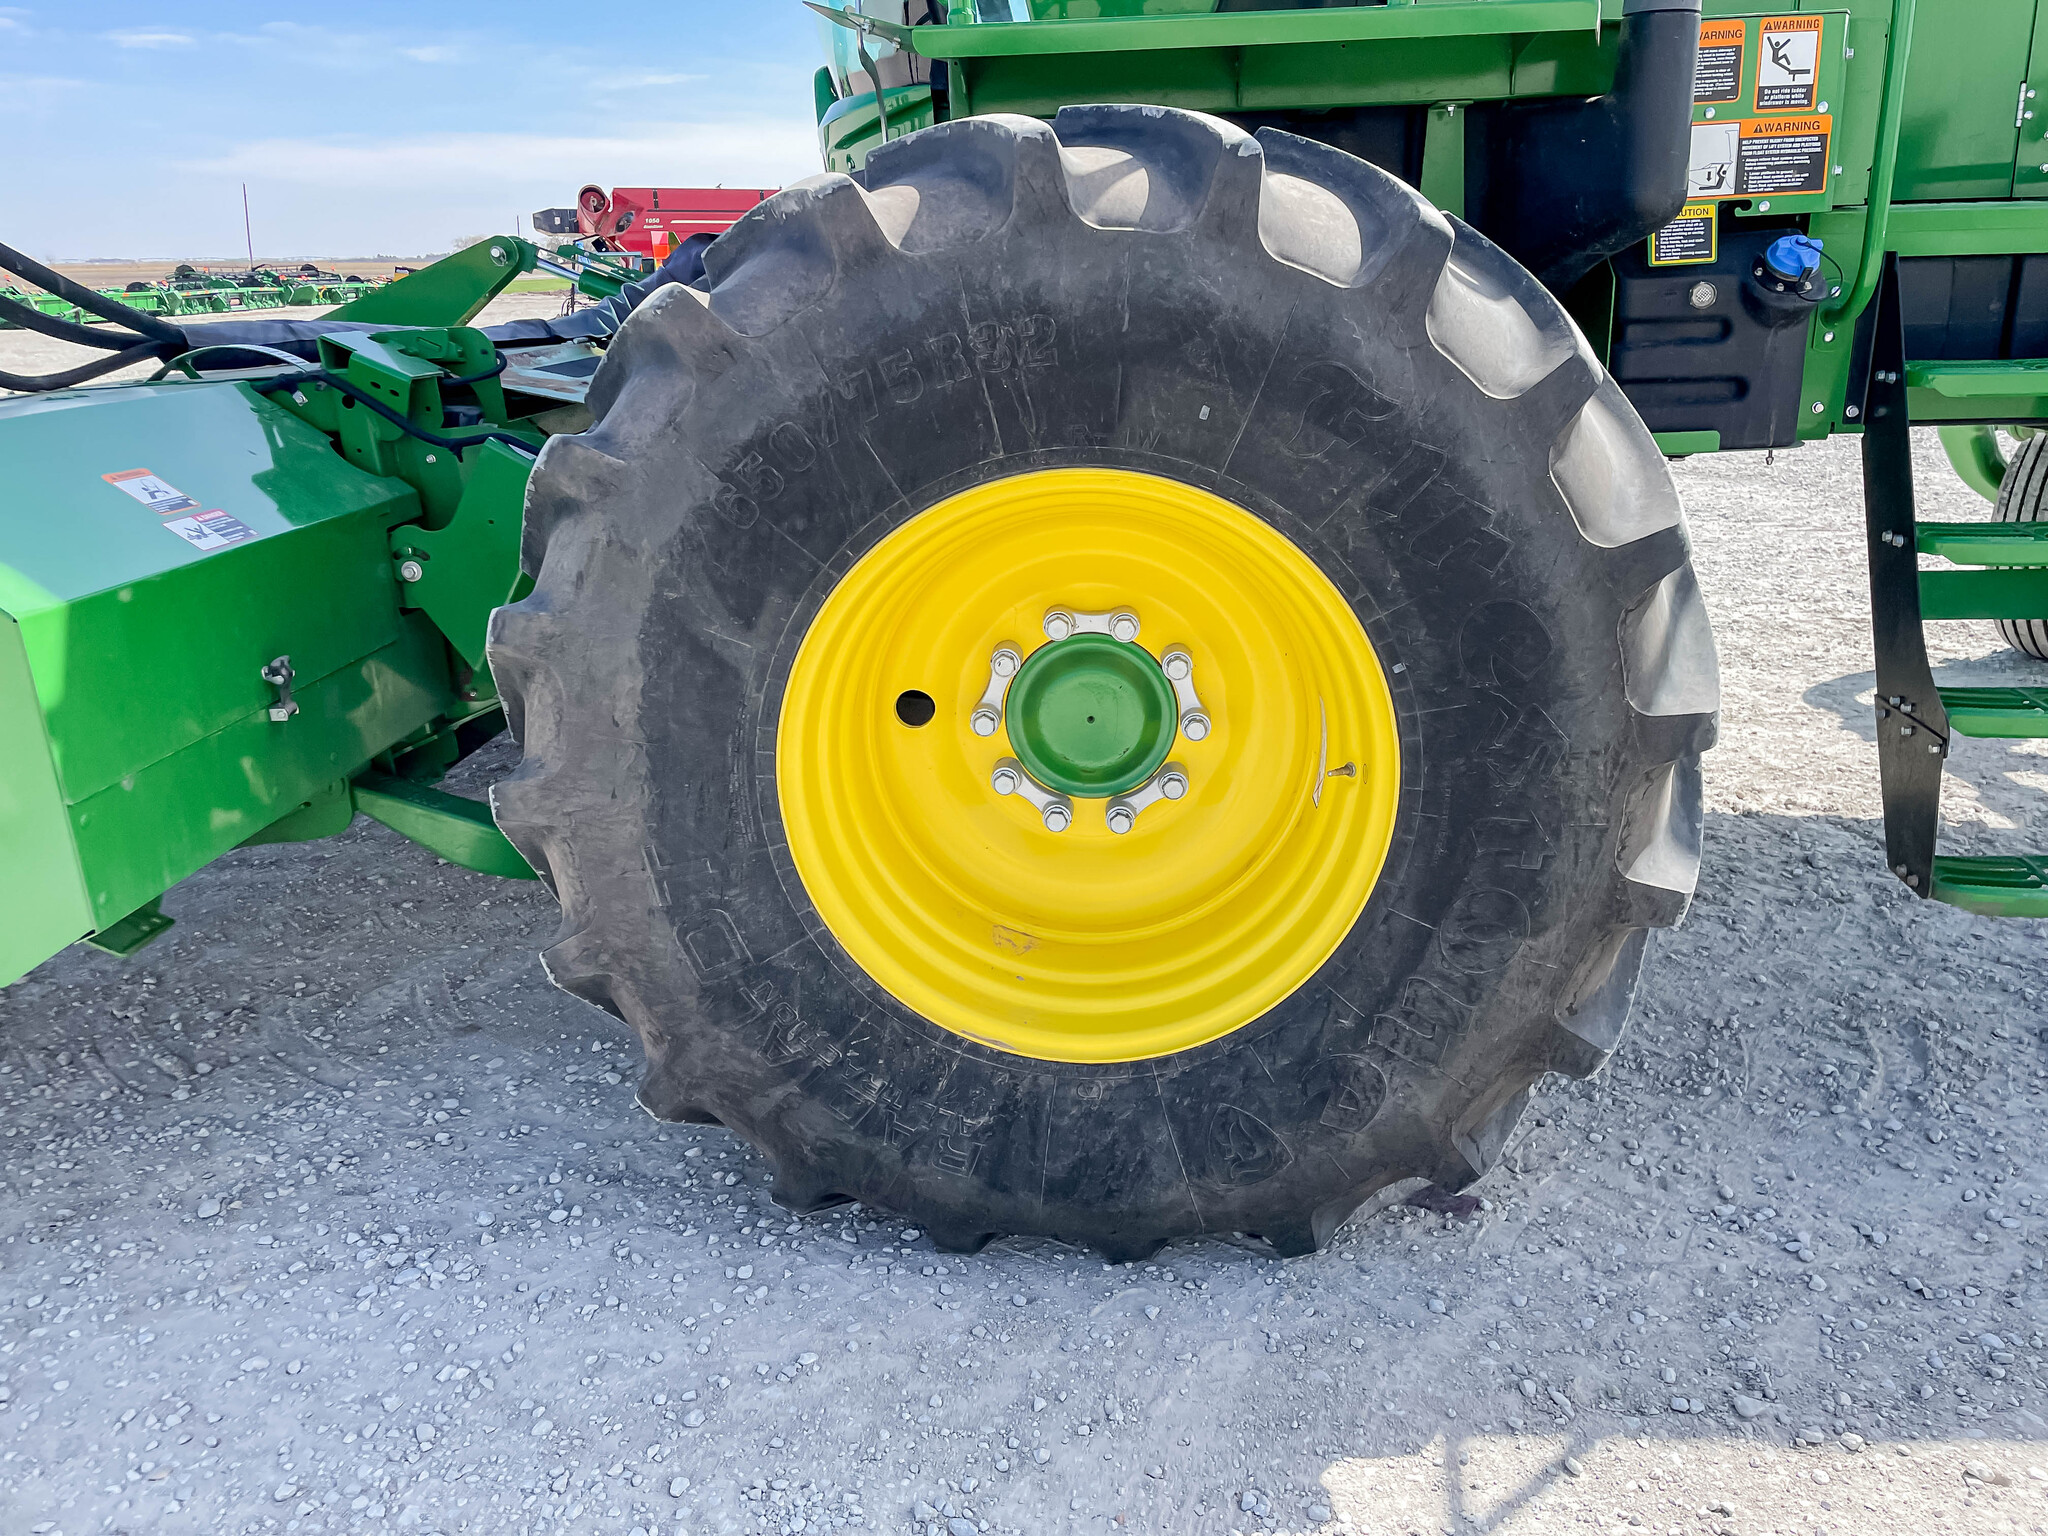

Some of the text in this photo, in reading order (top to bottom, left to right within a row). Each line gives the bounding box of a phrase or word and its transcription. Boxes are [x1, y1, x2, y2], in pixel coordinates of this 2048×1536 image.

[1773, 19, 1820, 30] WARNING
[1699, 29, 1743, 41] ARNING
[1764, 121, 1820, 132] WARNING
